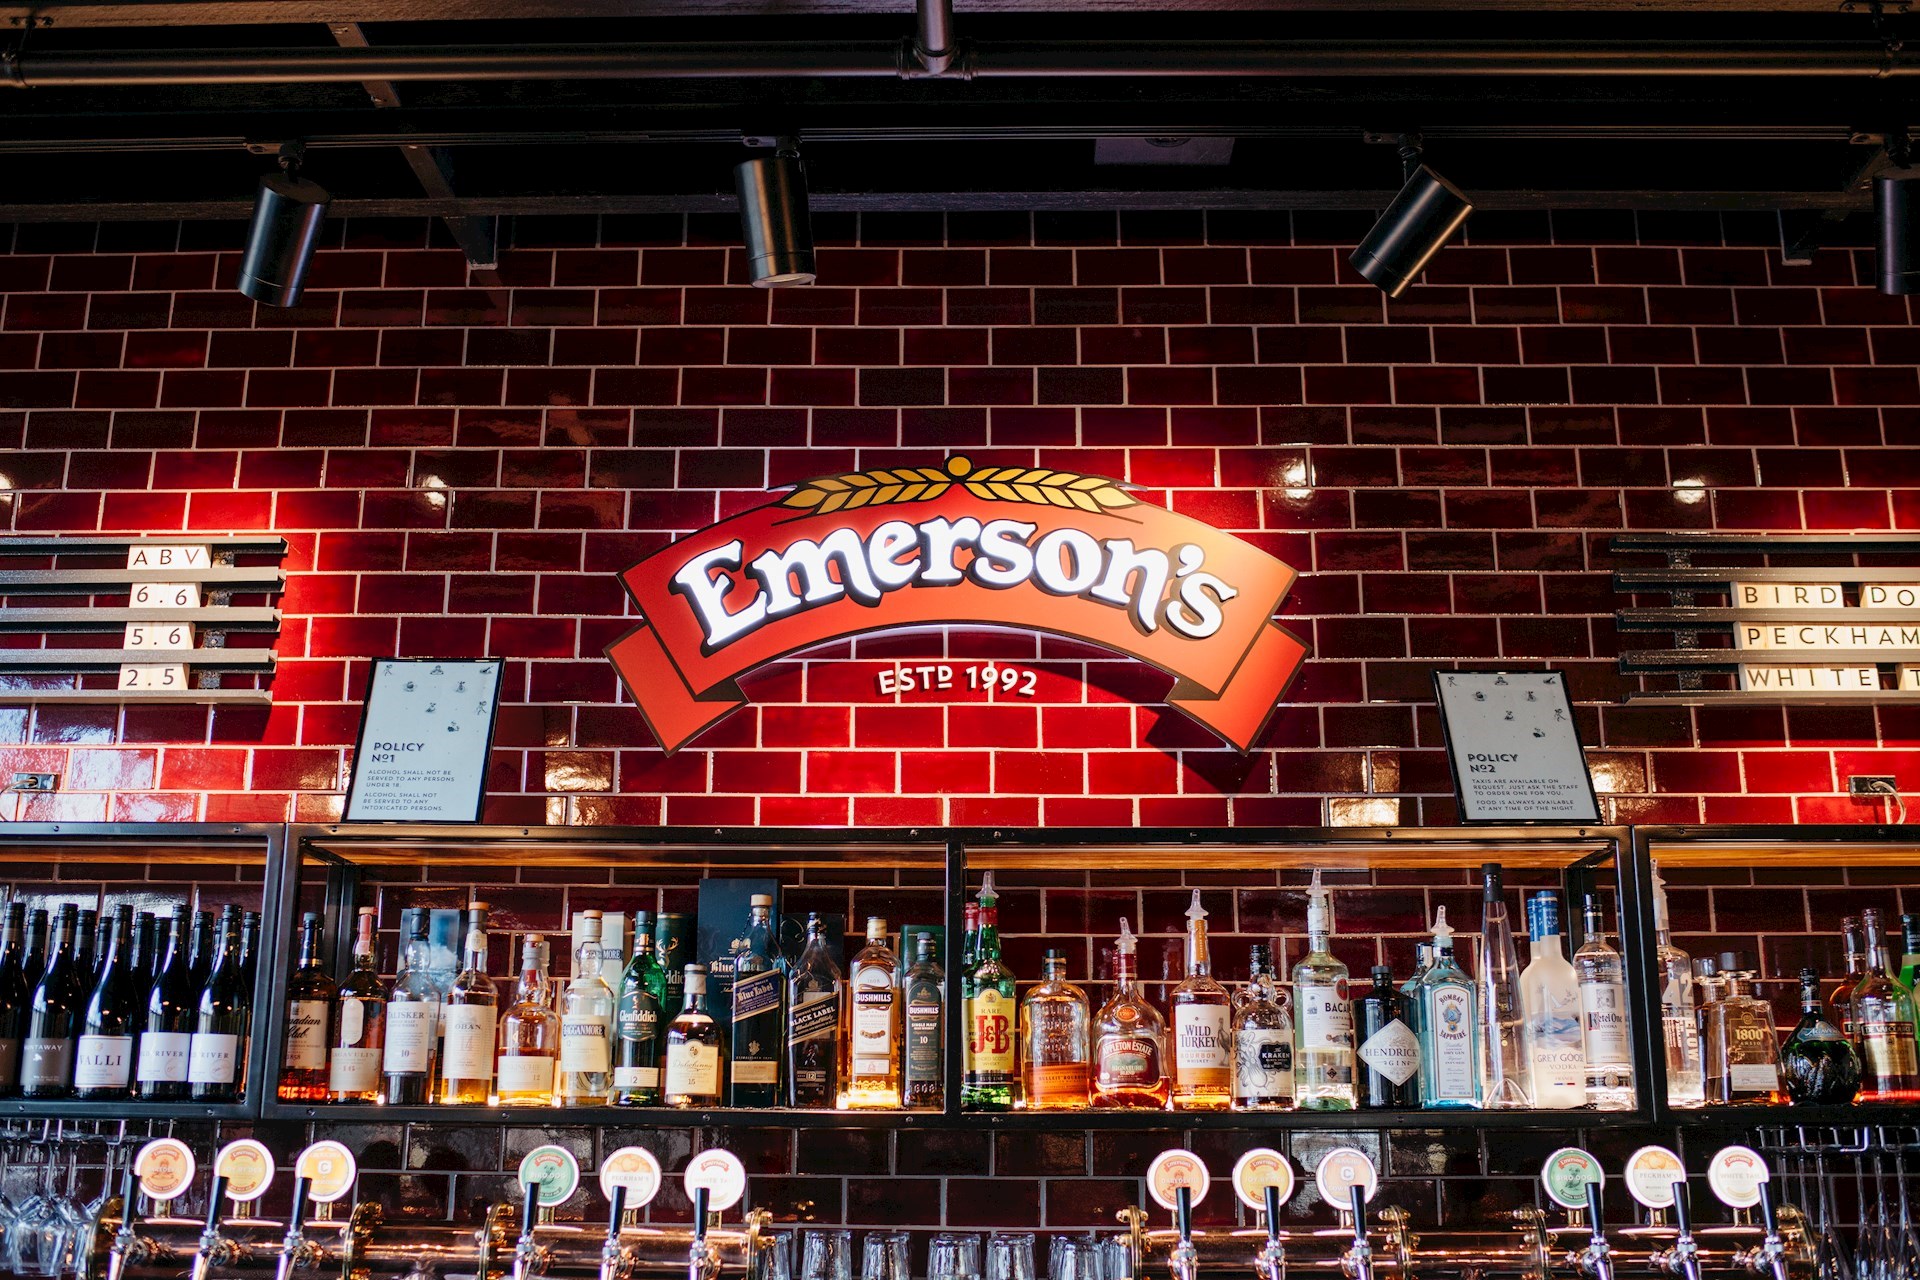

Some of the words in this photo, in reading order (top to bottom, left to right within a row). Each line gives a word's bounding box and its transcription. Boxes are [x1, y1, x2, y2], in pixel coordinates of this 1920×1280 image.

[133, 548, 200, 566] ABV
[670, 515, 1239, 652] Emerson's
[136, 586, 188, 606] 6.6
[1744, 586, 1838, 605] BIRD
[131, 627, 181, 646] 5.6
[1747, 627, 1920, 646] PECKHAM
[126, 668, 175, 688] 2.5
[878, 665, 954, 695] ESTD
[965, 665, 1038, 696] 1992
[1747, 668, 1873, 687] WHITE
[373, 742, 426, 752] POLICY
[1467, 753, 1519, 762] POLICY
[709, 960, 735, 973] Blue
[736, 990, 756, 1003] Blue
[755, 982, 774, 997] Label
[855, 993, 892, 1003] BUSHMILLS
[1438, 993, 1464, 1005] BOMBAY
[909, 1006, 939, 1014] BUSHMILLS
[1325, 1002, 1350, 1013] BACA
[387, 1011, 425, 1019] TALISKER
[619, 1010, 658, 1022] Glenfiddich
[790, 1015, 813, 1027] BLACK
[812, 1006, 836, 1019] LABEL
[1611, 1013, 1623, 1023] One
[969, 1015, 1010, 1054] J&B
[1185, 1025, 1211, 1036] WILD
[1438, 1029, 1467, 1040] SAPPHIRE
[1735, 1029, 1763, 1040] 1800
[919, 1036, 928, 1044] 10
[1180, 1034, 1217, 1048] TURKEY
[401, 1049, 410, 1057] 10
[1102, 1041, 1132, 1056] APPLETON
[1132, 1041, 1153, 1056] ESTATE
[1365, 1048, 1417, 1057] HENDRICK
[80, 1055, 122, 1066] VALLI
[1537, 1054, 1557, 1063] GREY
[321, 1162, 329, 1171] C
[1343, 1169, 1351, 1178] C
